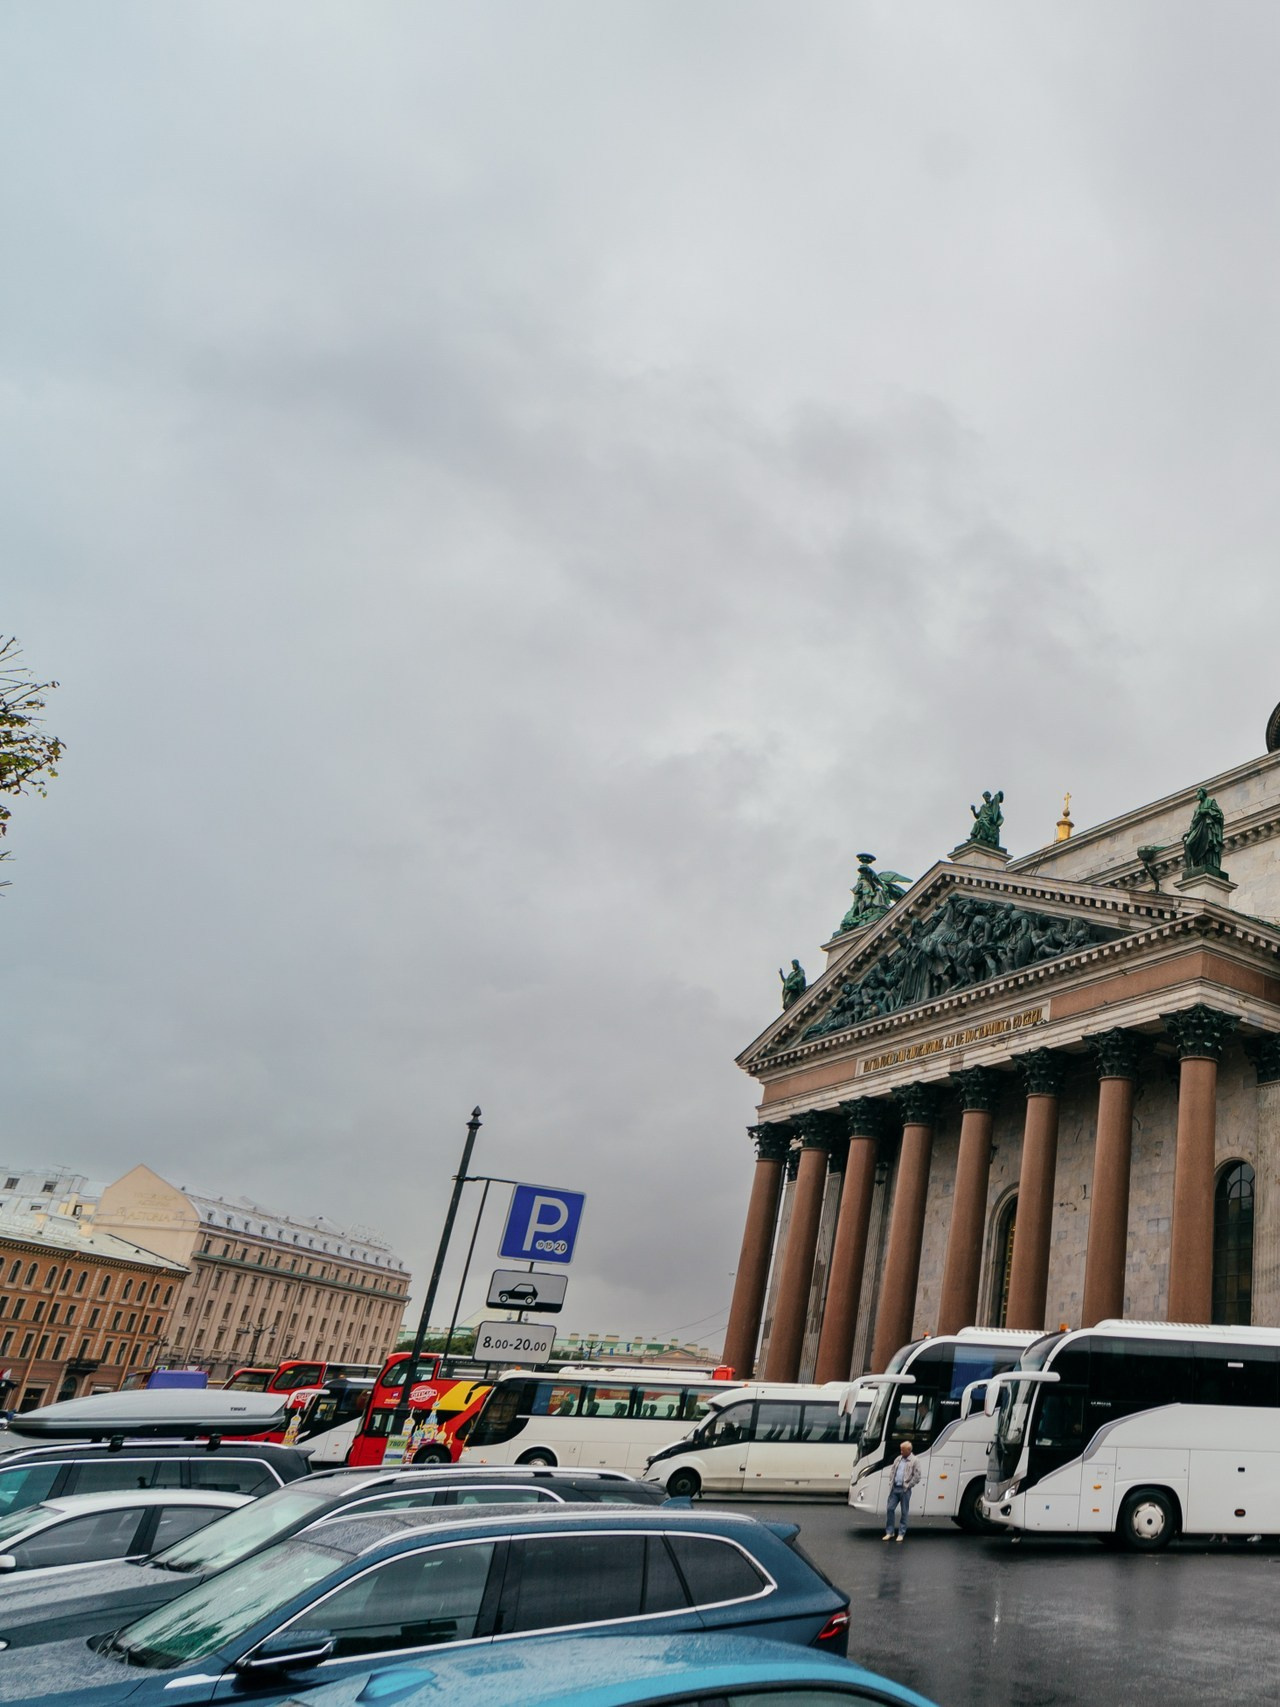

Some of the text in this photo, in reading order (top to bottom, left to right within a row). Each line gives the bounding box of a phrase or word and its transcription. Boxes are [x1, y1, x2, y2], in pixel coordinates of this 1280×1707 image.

[522, 1195, 569, 1252] P
[545, 1242, 553, 1250] 15
[555, 1242, 566, 1251] 20
[482, 1335, 547, 1352] 8.00-20.00
